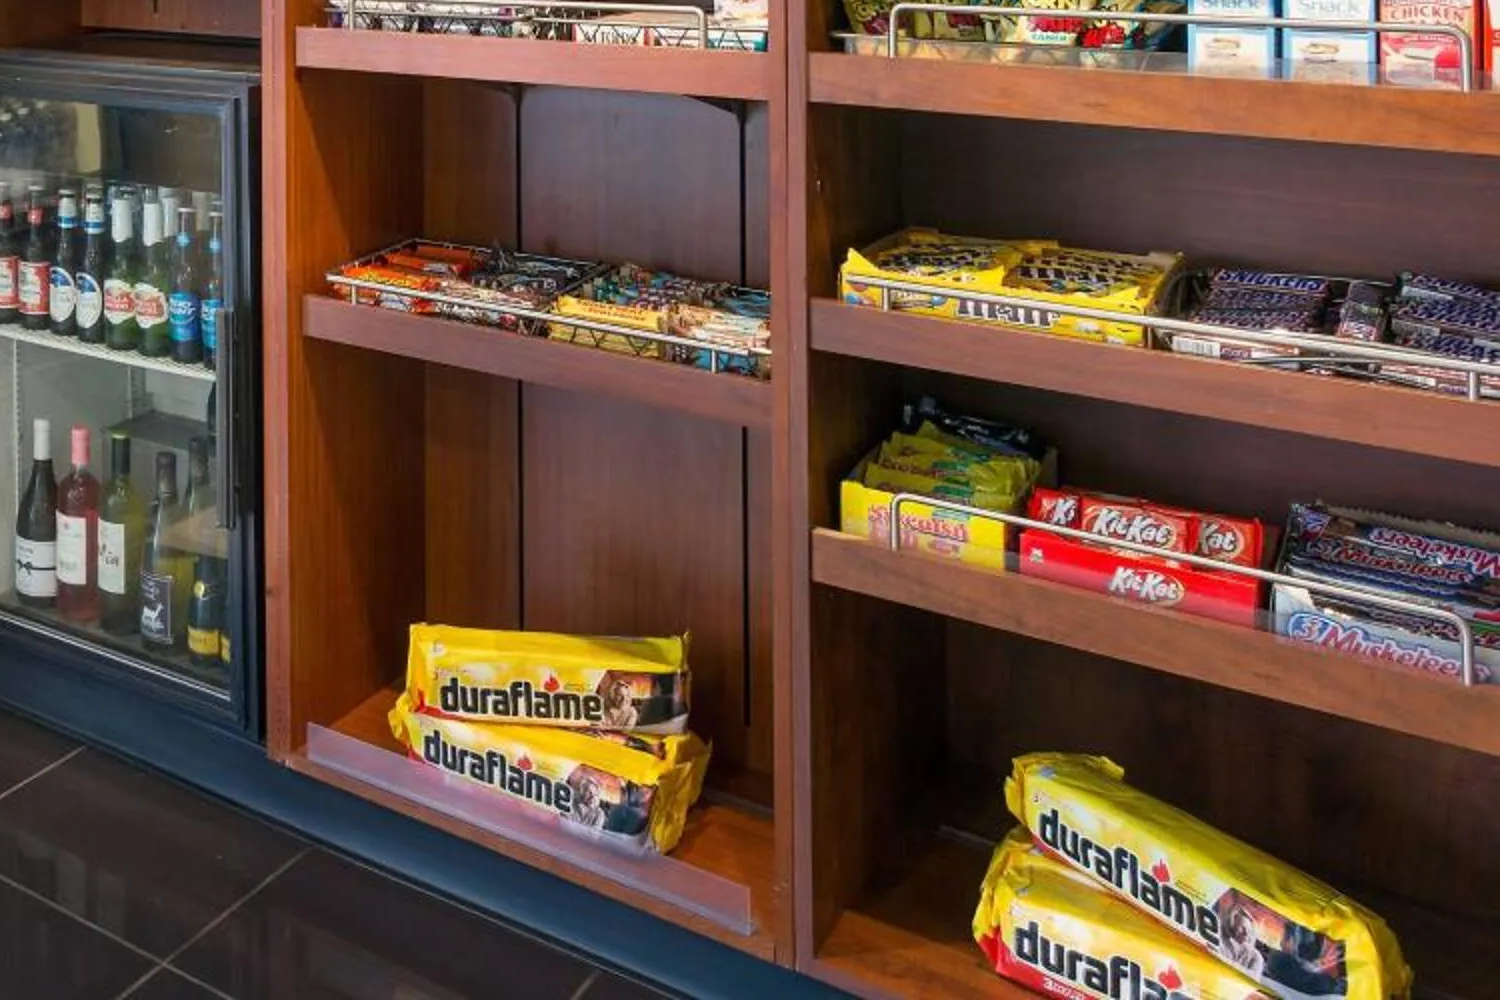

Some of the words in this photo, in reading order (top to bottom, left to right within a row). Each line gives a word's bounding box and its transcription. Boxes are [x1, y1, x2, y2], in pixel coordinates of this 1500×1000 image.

[1391, 5, 1464, 22] CHICKEN
[1318, 622, 1493, 684] Musketees
[440, 677, 603, 722] duraflame
[423, 730, 573, 814] duraflame
[1038, 808, 1222, 947] duraflame
[1013, 921, 1193, 1000] durafla
